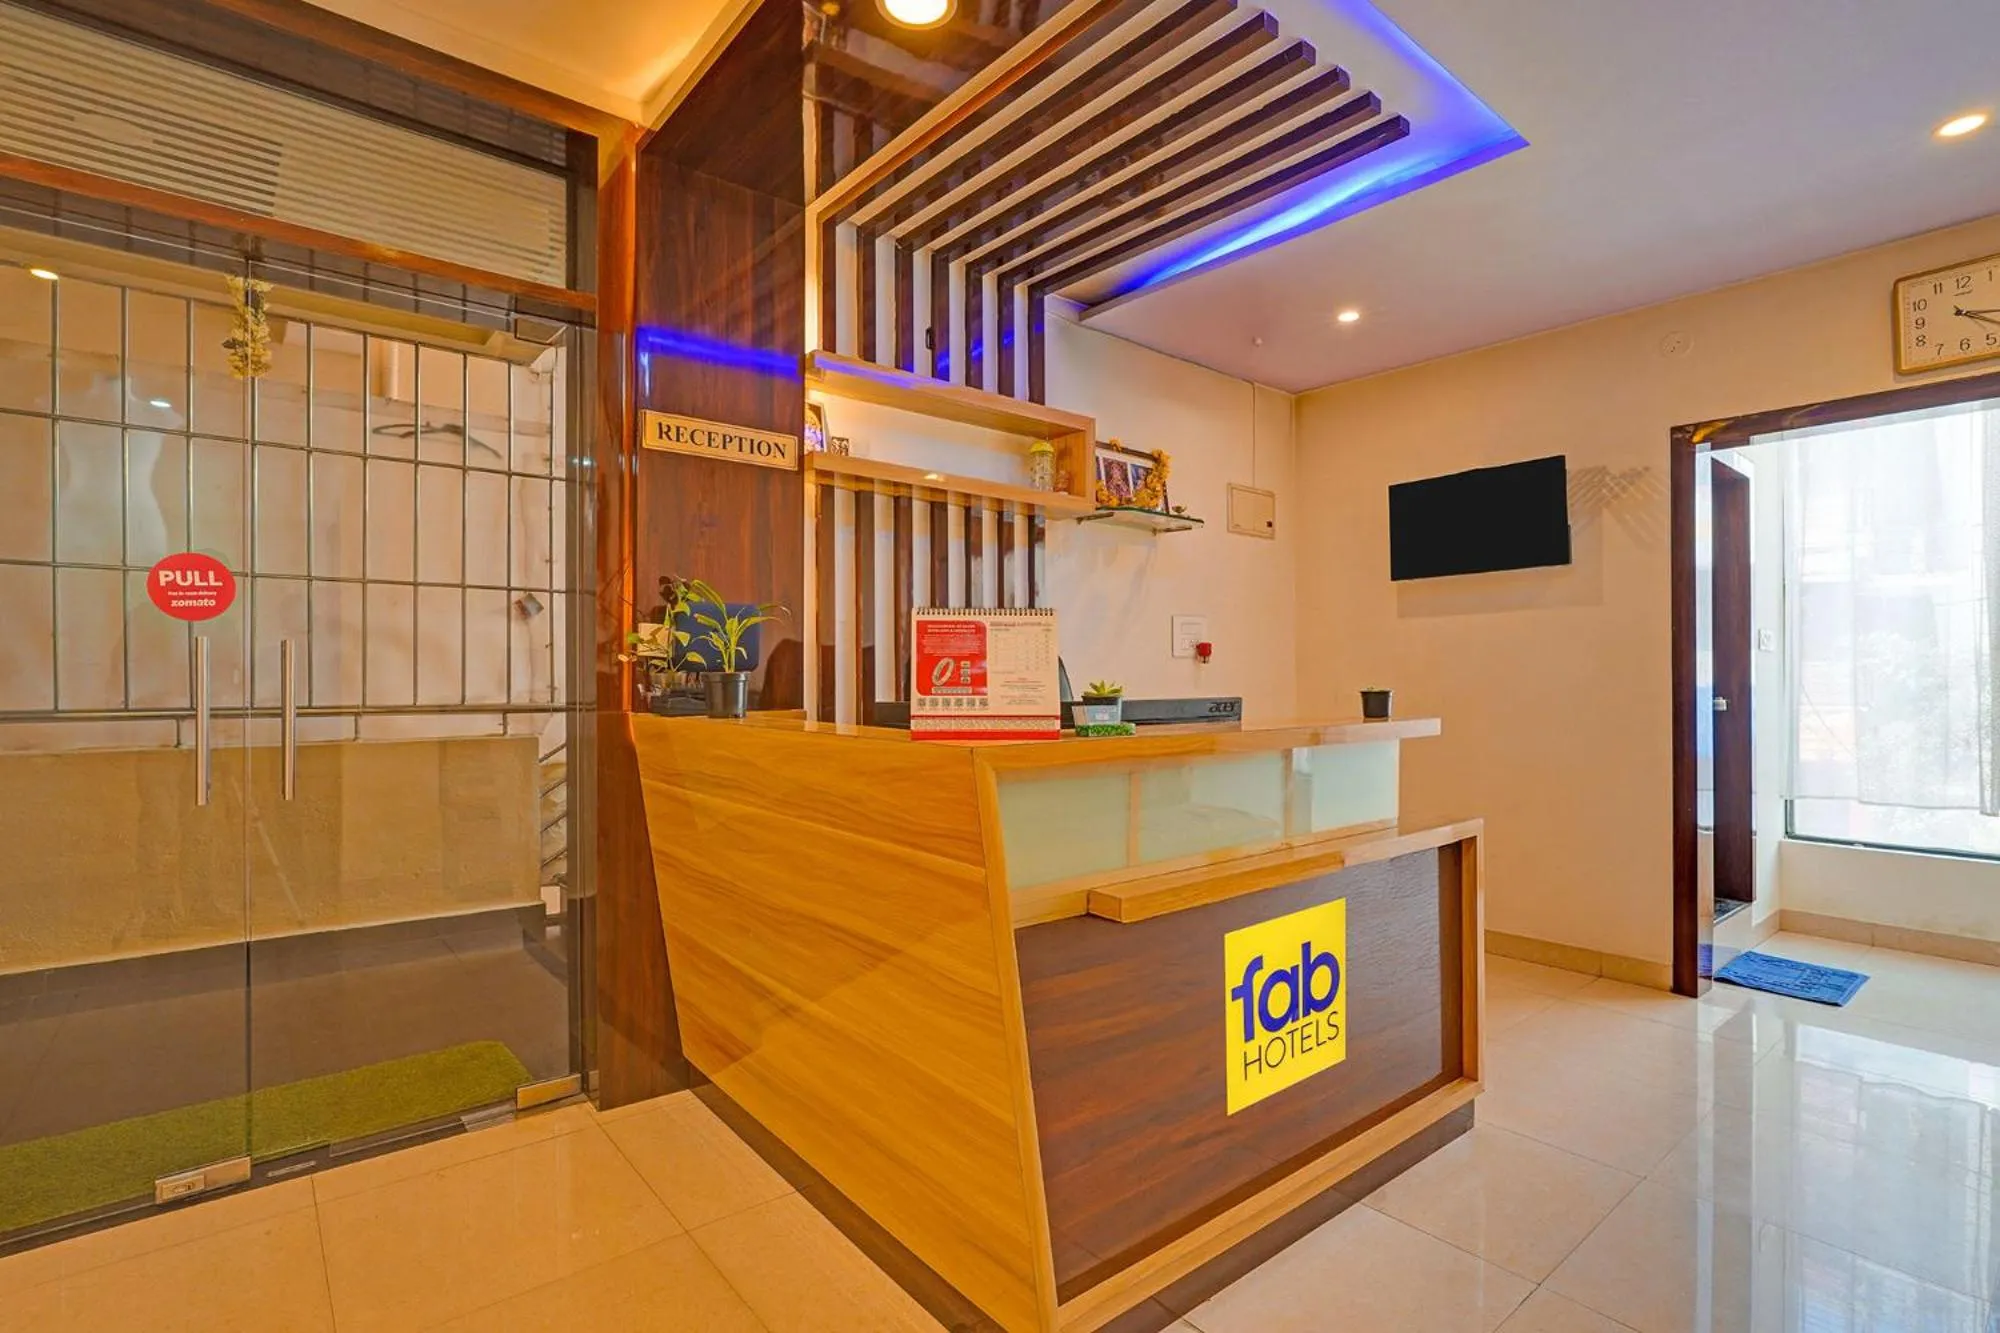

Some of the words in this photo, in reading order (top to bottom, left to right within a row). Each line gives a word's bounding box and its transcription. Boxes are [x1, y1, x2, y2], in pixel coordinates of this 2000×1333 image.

[1933, 282, 1943, 295] 11
[1955, 276, 1971, 289] 12
[1988, 270, 1993, 282] 1
[1912, 298, 1928, 312] 10
[1915, 317, 1926, 330] 9
[1915, 334, 1927, 348] 8
[1934, 343, 1945, 356] 7
[1959, 337, 1971, 352] 6
[1985, 332, 1998, 346] 5
[657, 422, 787, 459] RECEPTION
[158, 570, 224, 587] PULL
[170, 598, 217, 608] zomato
[1207, 700, 1240, 713] acer
[1231, 940, 1341, 1044] fab
[1243, 1010, 1340, 1081] HOTELS
